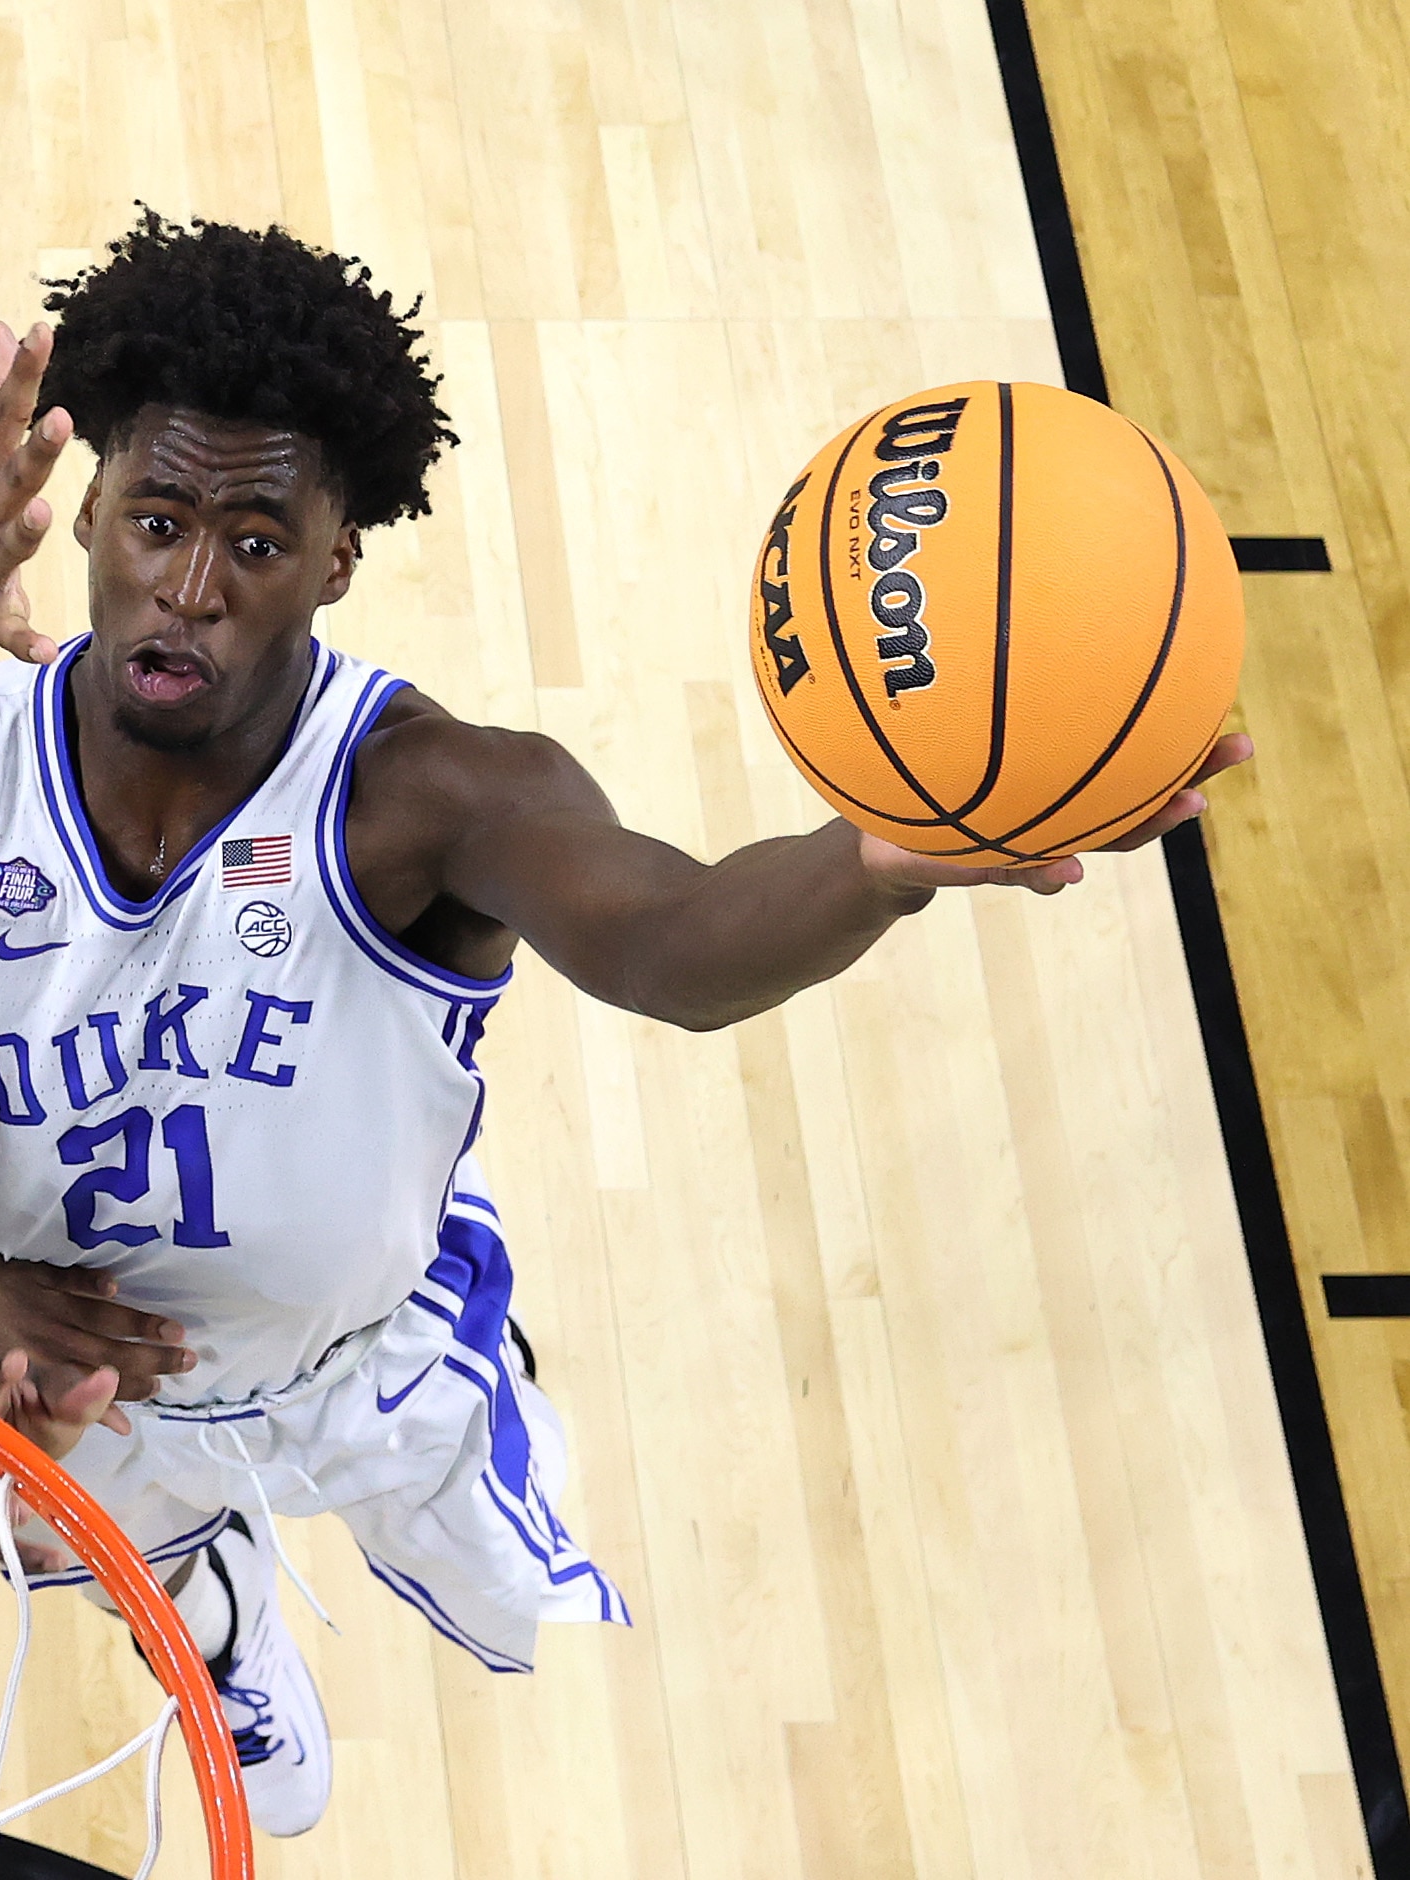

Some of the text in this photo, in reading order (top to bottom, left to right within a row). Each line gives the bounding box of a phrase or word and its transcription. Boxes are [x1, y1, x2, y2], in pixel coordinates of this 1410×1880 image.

[760, 471, 812, 698] NCAA
[848, 489, 863, 581] EVO NXT
[862, 396, 972, 700] Wilson
[2, 872, 36, 888] FINAL
[244, 918, 287, 934] ACC
[56, 1103, 232, 1250] 21
